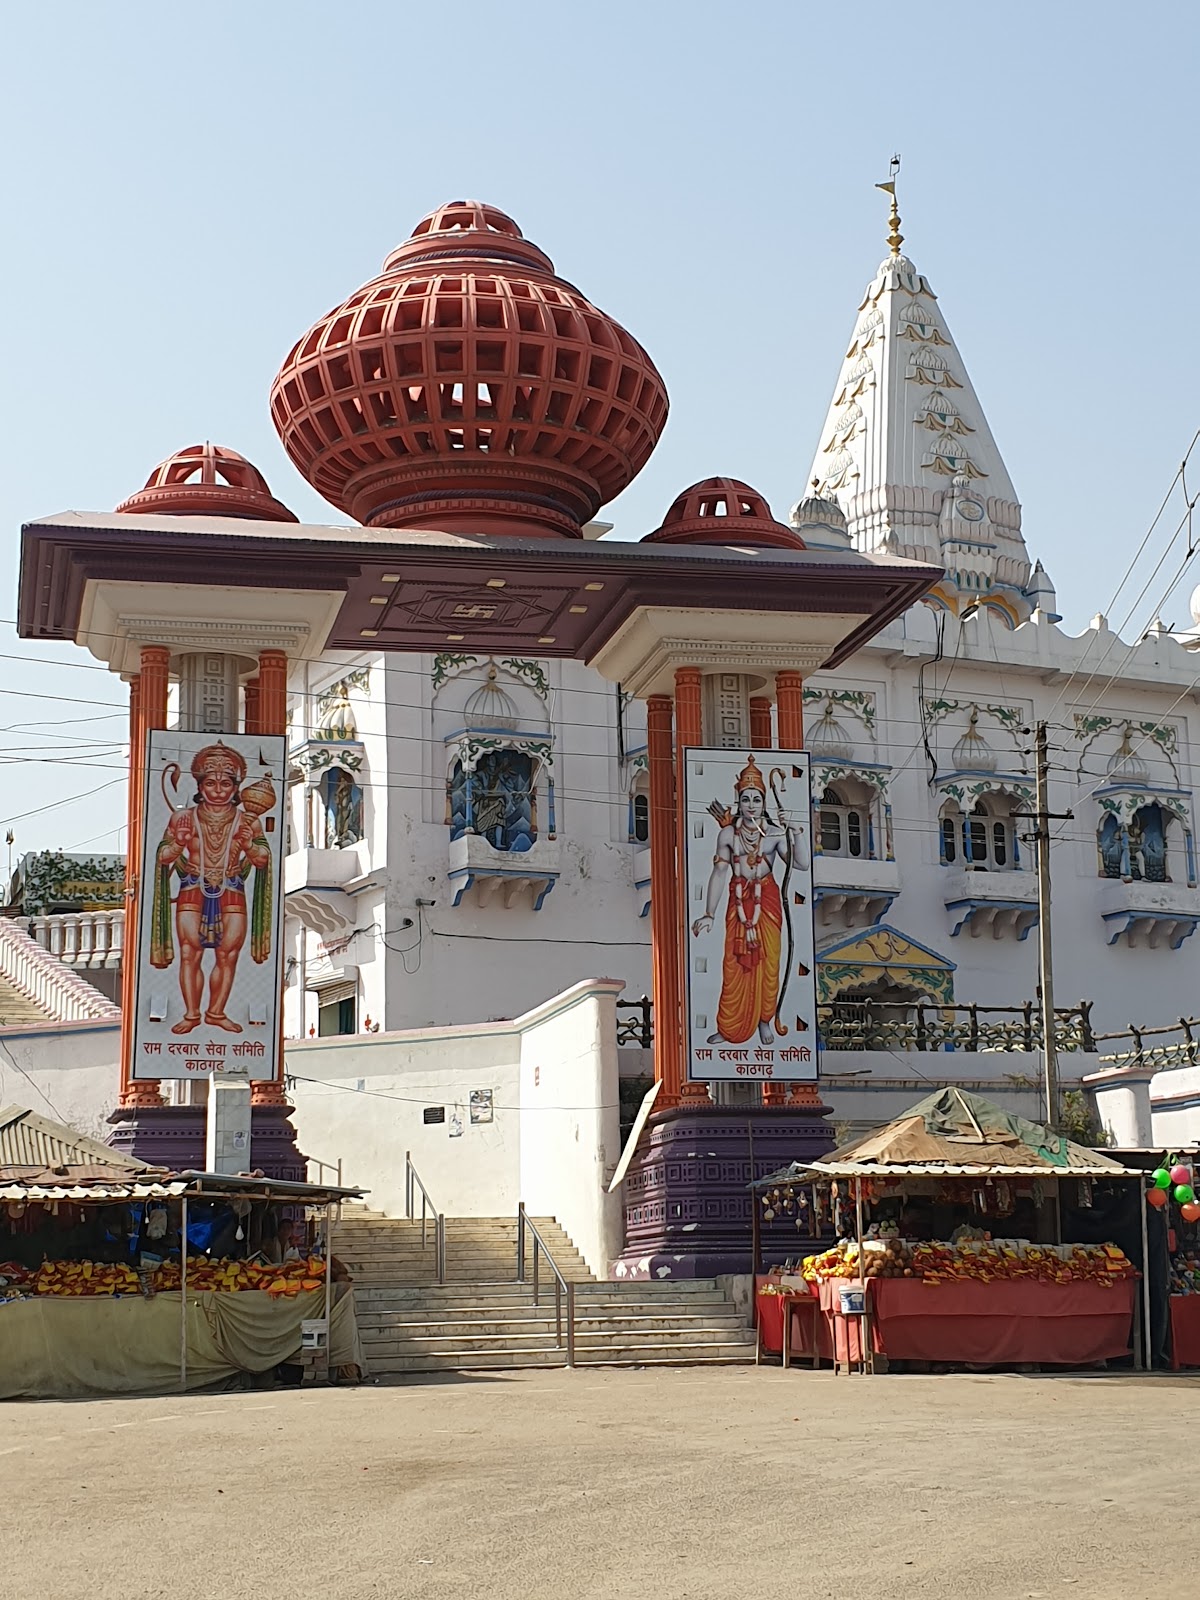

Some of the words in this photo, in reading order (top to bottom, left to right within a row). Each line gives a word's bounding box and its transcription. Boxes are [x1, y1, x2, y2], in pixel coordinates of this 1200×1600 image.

[143, 1042, 162, 1055] राम
[167, 1042, 200, 1056] दरबार
[205, 1040, 227, 1056] सेवा
[232, 1041, 266, 1057] समिति
[695, 1048, 713, 1061] राम
[718, 1049, 749, 1062] दरबार
[754, 1046, 775, 1062] सेवा
[779, 1046, 812, 1062] समिति
[735, 1064, 774, 1078] काठगढ़
